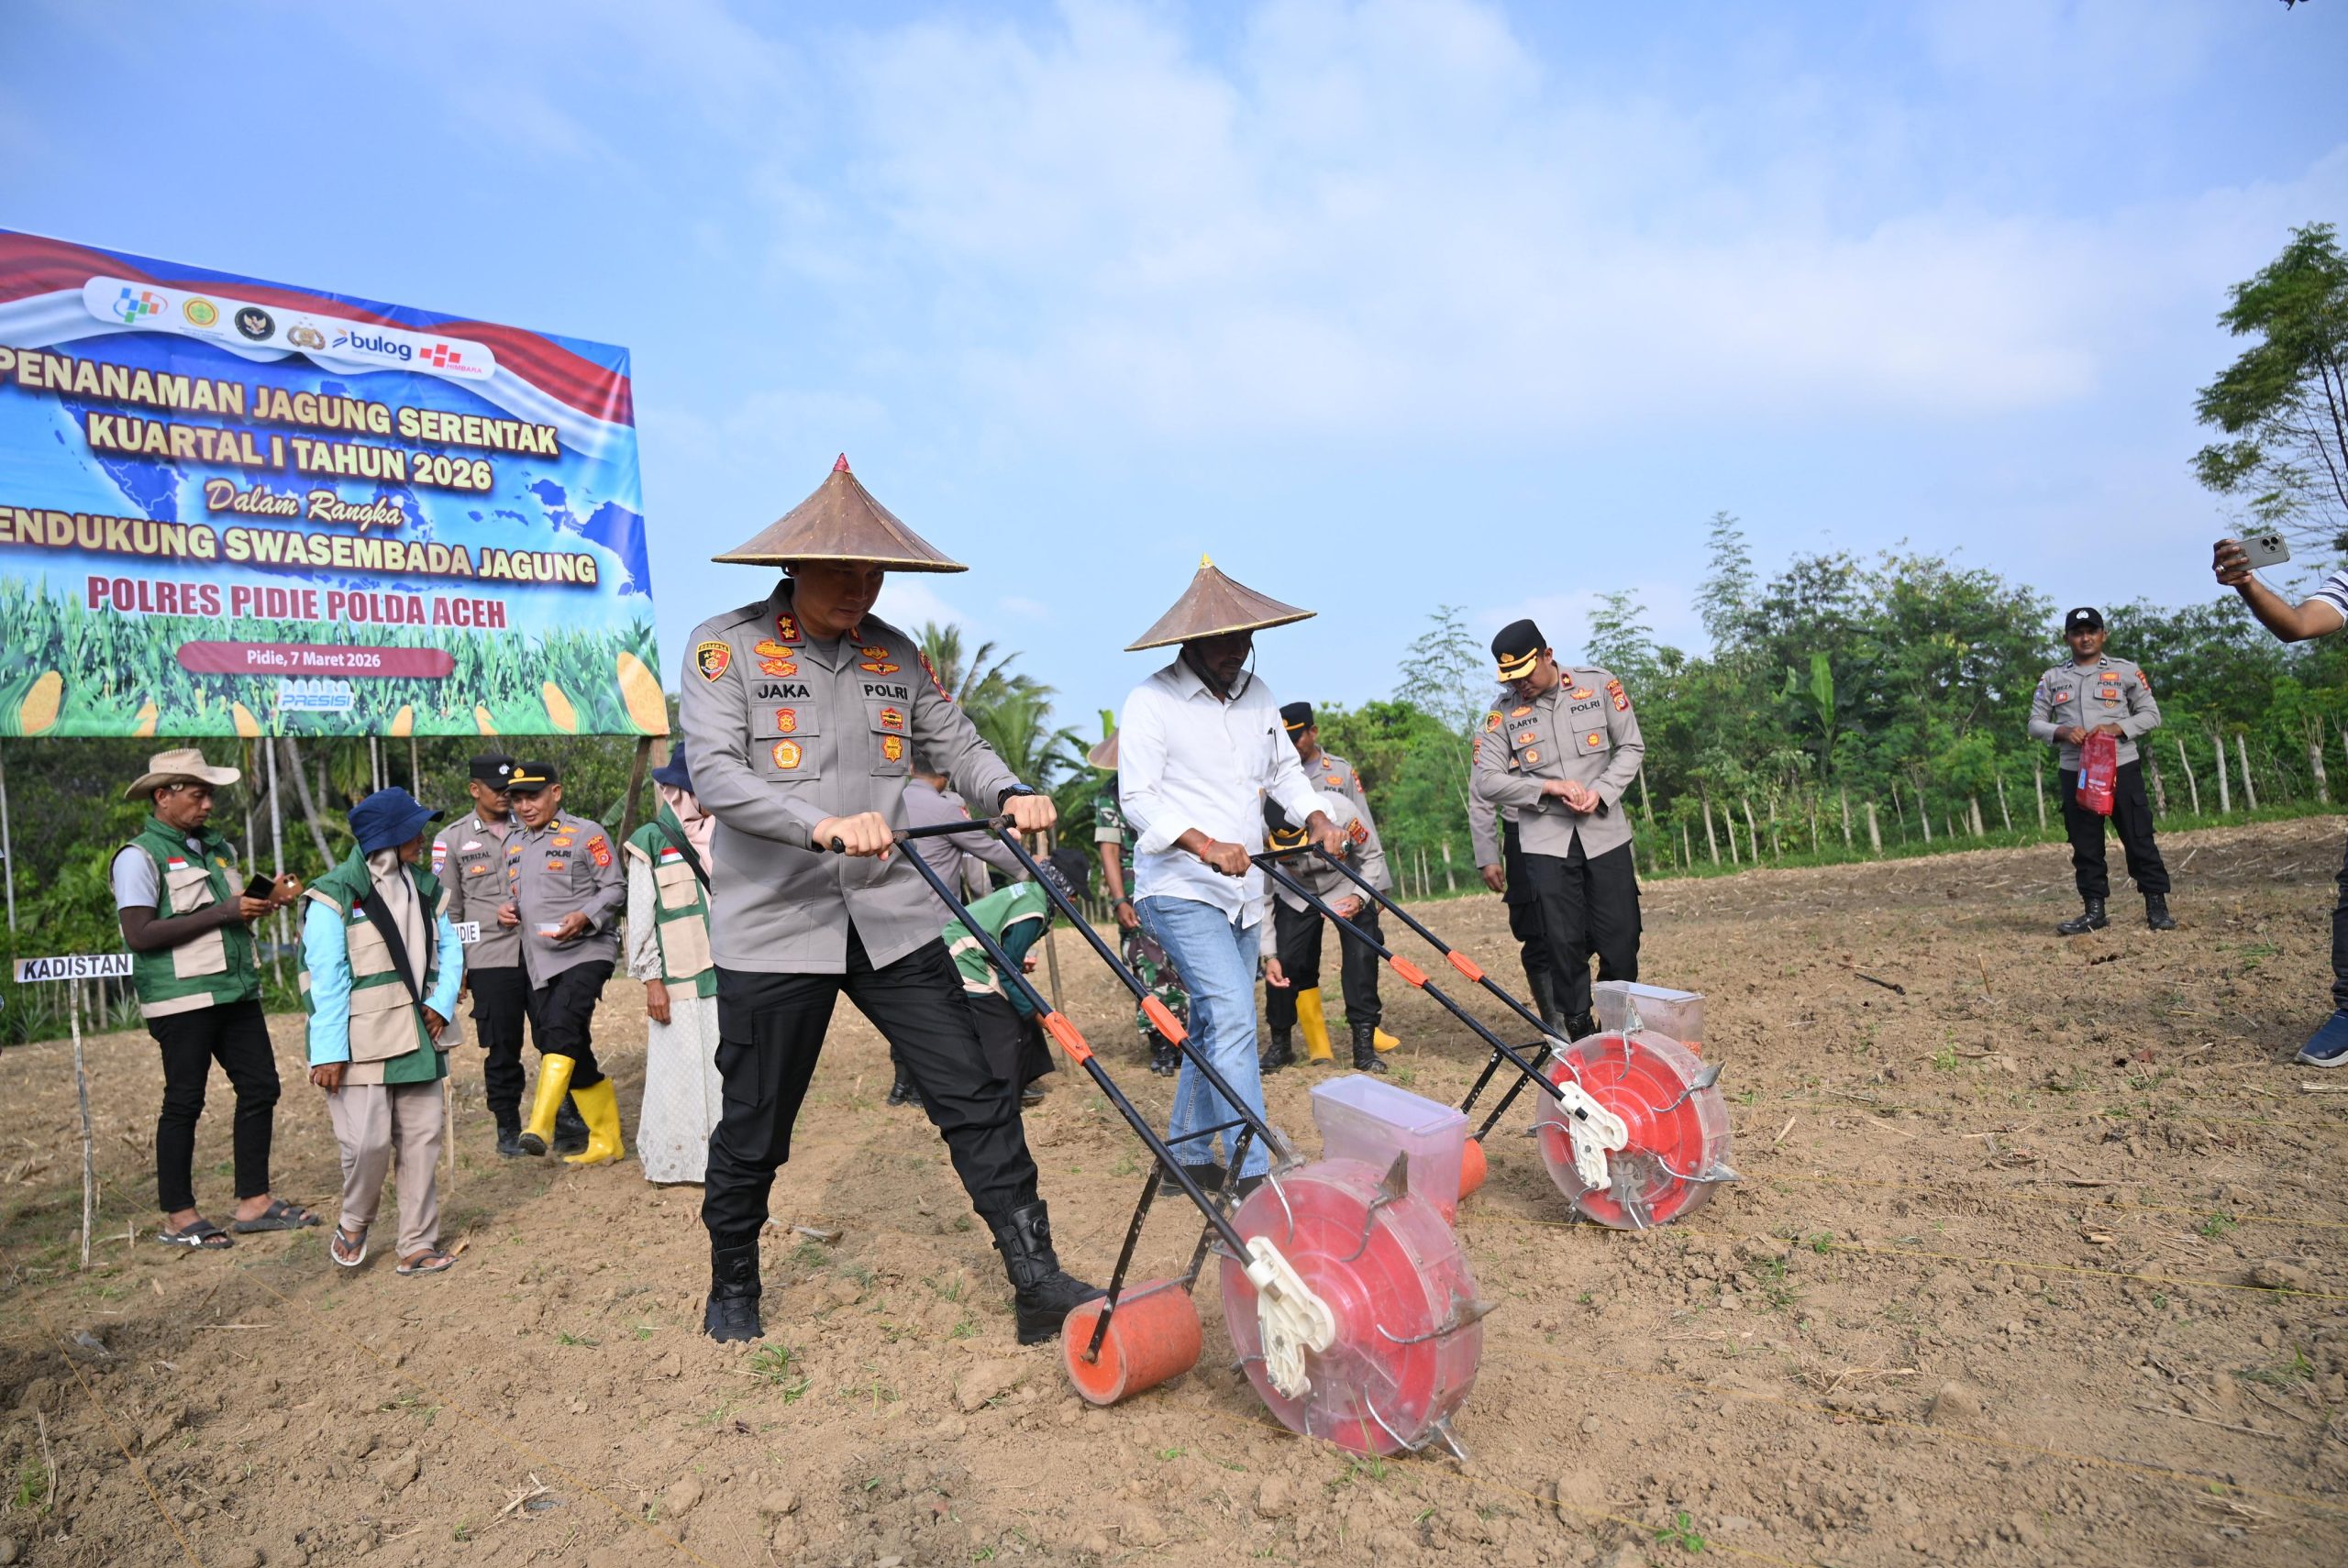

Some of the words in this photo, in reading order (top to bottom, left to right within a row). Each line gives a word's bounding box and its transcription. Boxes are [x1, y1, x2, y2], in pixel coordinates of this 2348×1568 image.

[350, 331, 412, 361] bulog
[446, 363, 483, 374] HIMBARA
[0, 345, 245, 415] PENANAMAN
[252, 385, 393, 436] JAGUNG
[397, 406, 559, 456] SERENTAK
[88, 412, 264, 466] KUARTAL
[271, 436, 285, 468] I
[291, 437, 406, 481] TAHUN
[412, 453, 493, 491] 2026
[204, 478, 299, 515] Dalam
[306, 490, 404, 532] Rangka
[0, 506, 216, 558] ENDUKUNG
[225, 527, 473, 576] SWASEMBADA
[478, 548, 597, 583] JAGUNG
[87, 575, 222, 617] POLRES
[230, 585, 319, 621] PIDIE
[327, 590, 426, 625] POLDA
[432, 597, 507, 629] ACEH
[247, 649, 288, 667] Pidie,
[290, 651, 300, 666] 7
[303, 651, 344, 667] Maret
[347, 653, 382, 668] 2026
[282, 694, 351, 707] PRESISI
[758, 683, 811, 699] JAKA
[863, 684, 908, 701] POLRI
[1570, 699, 1600, 714] POLRI
[545, 849, 572, 858] POLRI
[24, 955, 128, 980] KADISTAN
